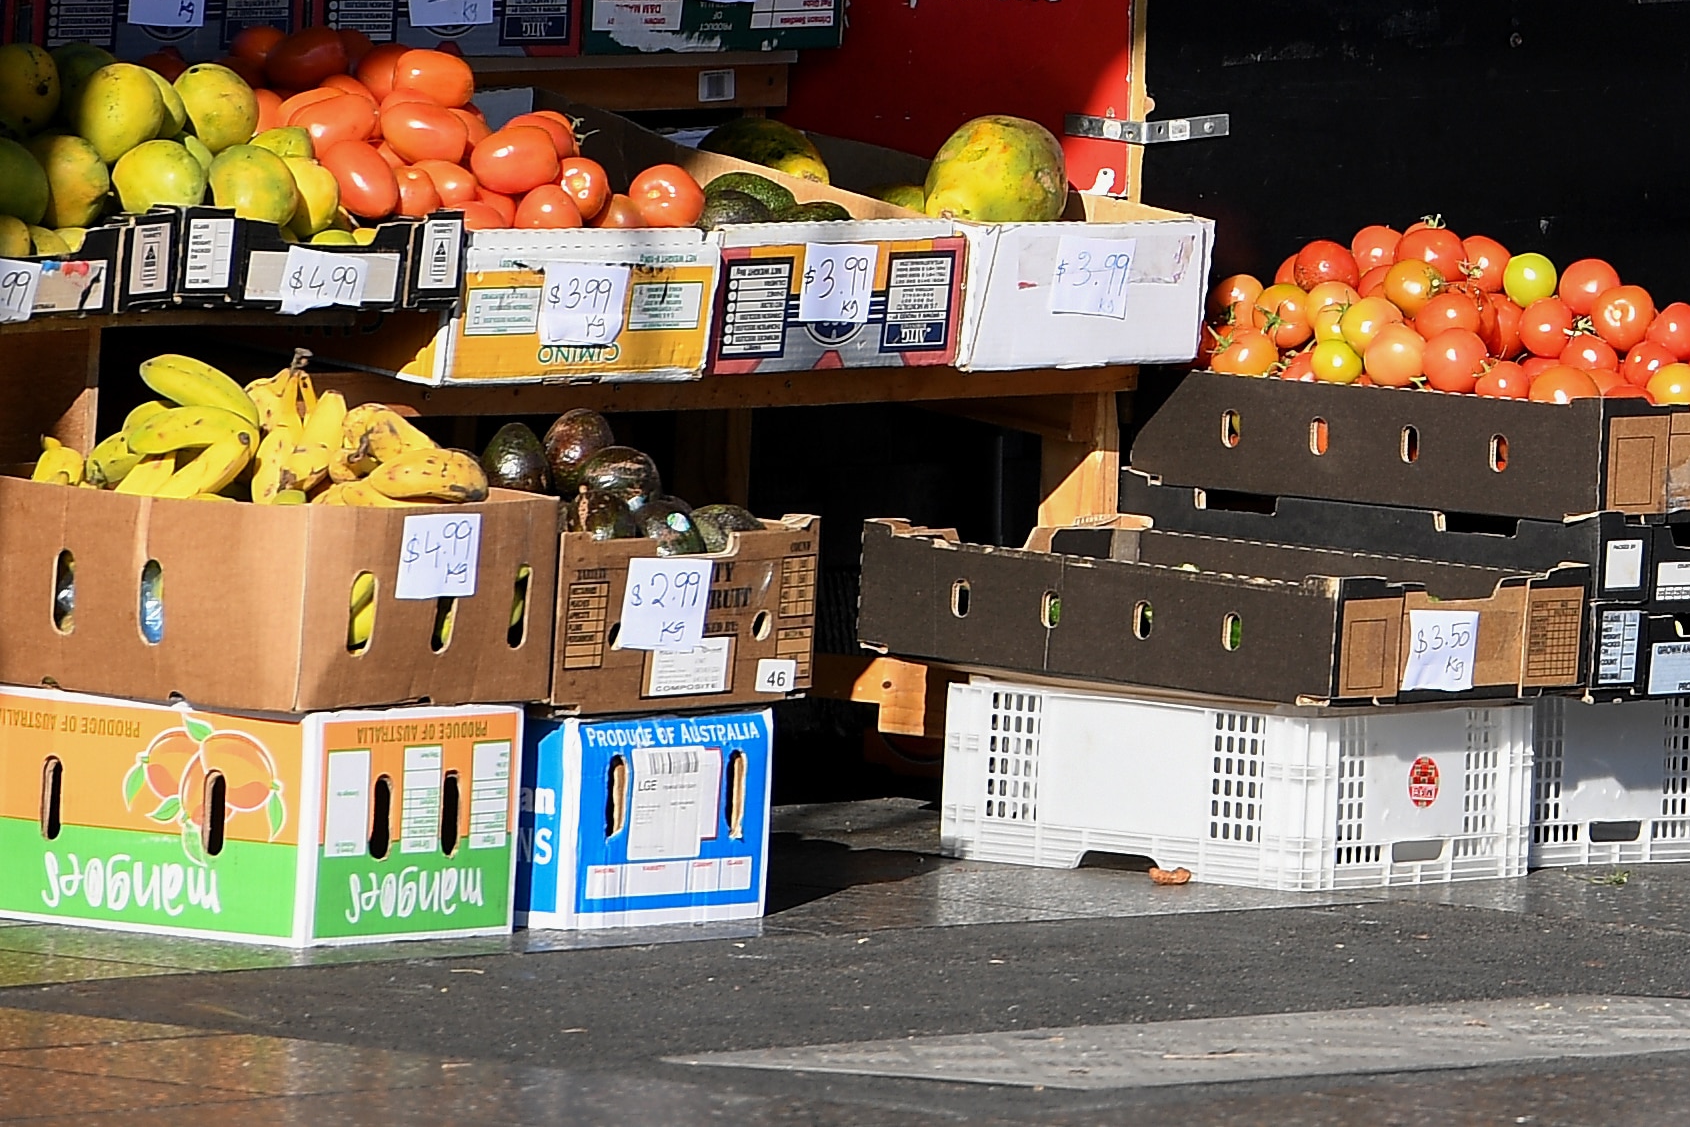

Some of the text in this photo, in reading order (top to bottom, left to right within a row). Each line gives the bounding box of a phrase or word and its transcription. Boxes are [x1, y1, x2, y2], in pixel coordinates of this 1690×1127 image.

[289, 265, 358, 300] $4.99
[804, 257, 868, 300] $3.99
[1055, 251, 1130, 297] $3.99
[547, 278, 613, 314] $3.99
[537, 344, 620, 364] CIMINO
[403, 520, 473, 573] $4.99
[631, 572, 701, 609] $2.99
[1414, 622, 1471, 660] $3.50
[655, 682, 717, 693] COMPOSITE
[766, 670, 785, 687] 46
[61, 715, 76, 733] OF
[81, 716, 141, 739] PRODUCE
[356, 721, 488, 744] PRODUCE OF AUSTRALIA
[586, 721, 760, 748] PRODUCE OF AUSTRALIA
[638, 779, 657, 792] LGE
[41, 850, 222, 917] mangoes
[345, 865, 485, 924] mangoes
